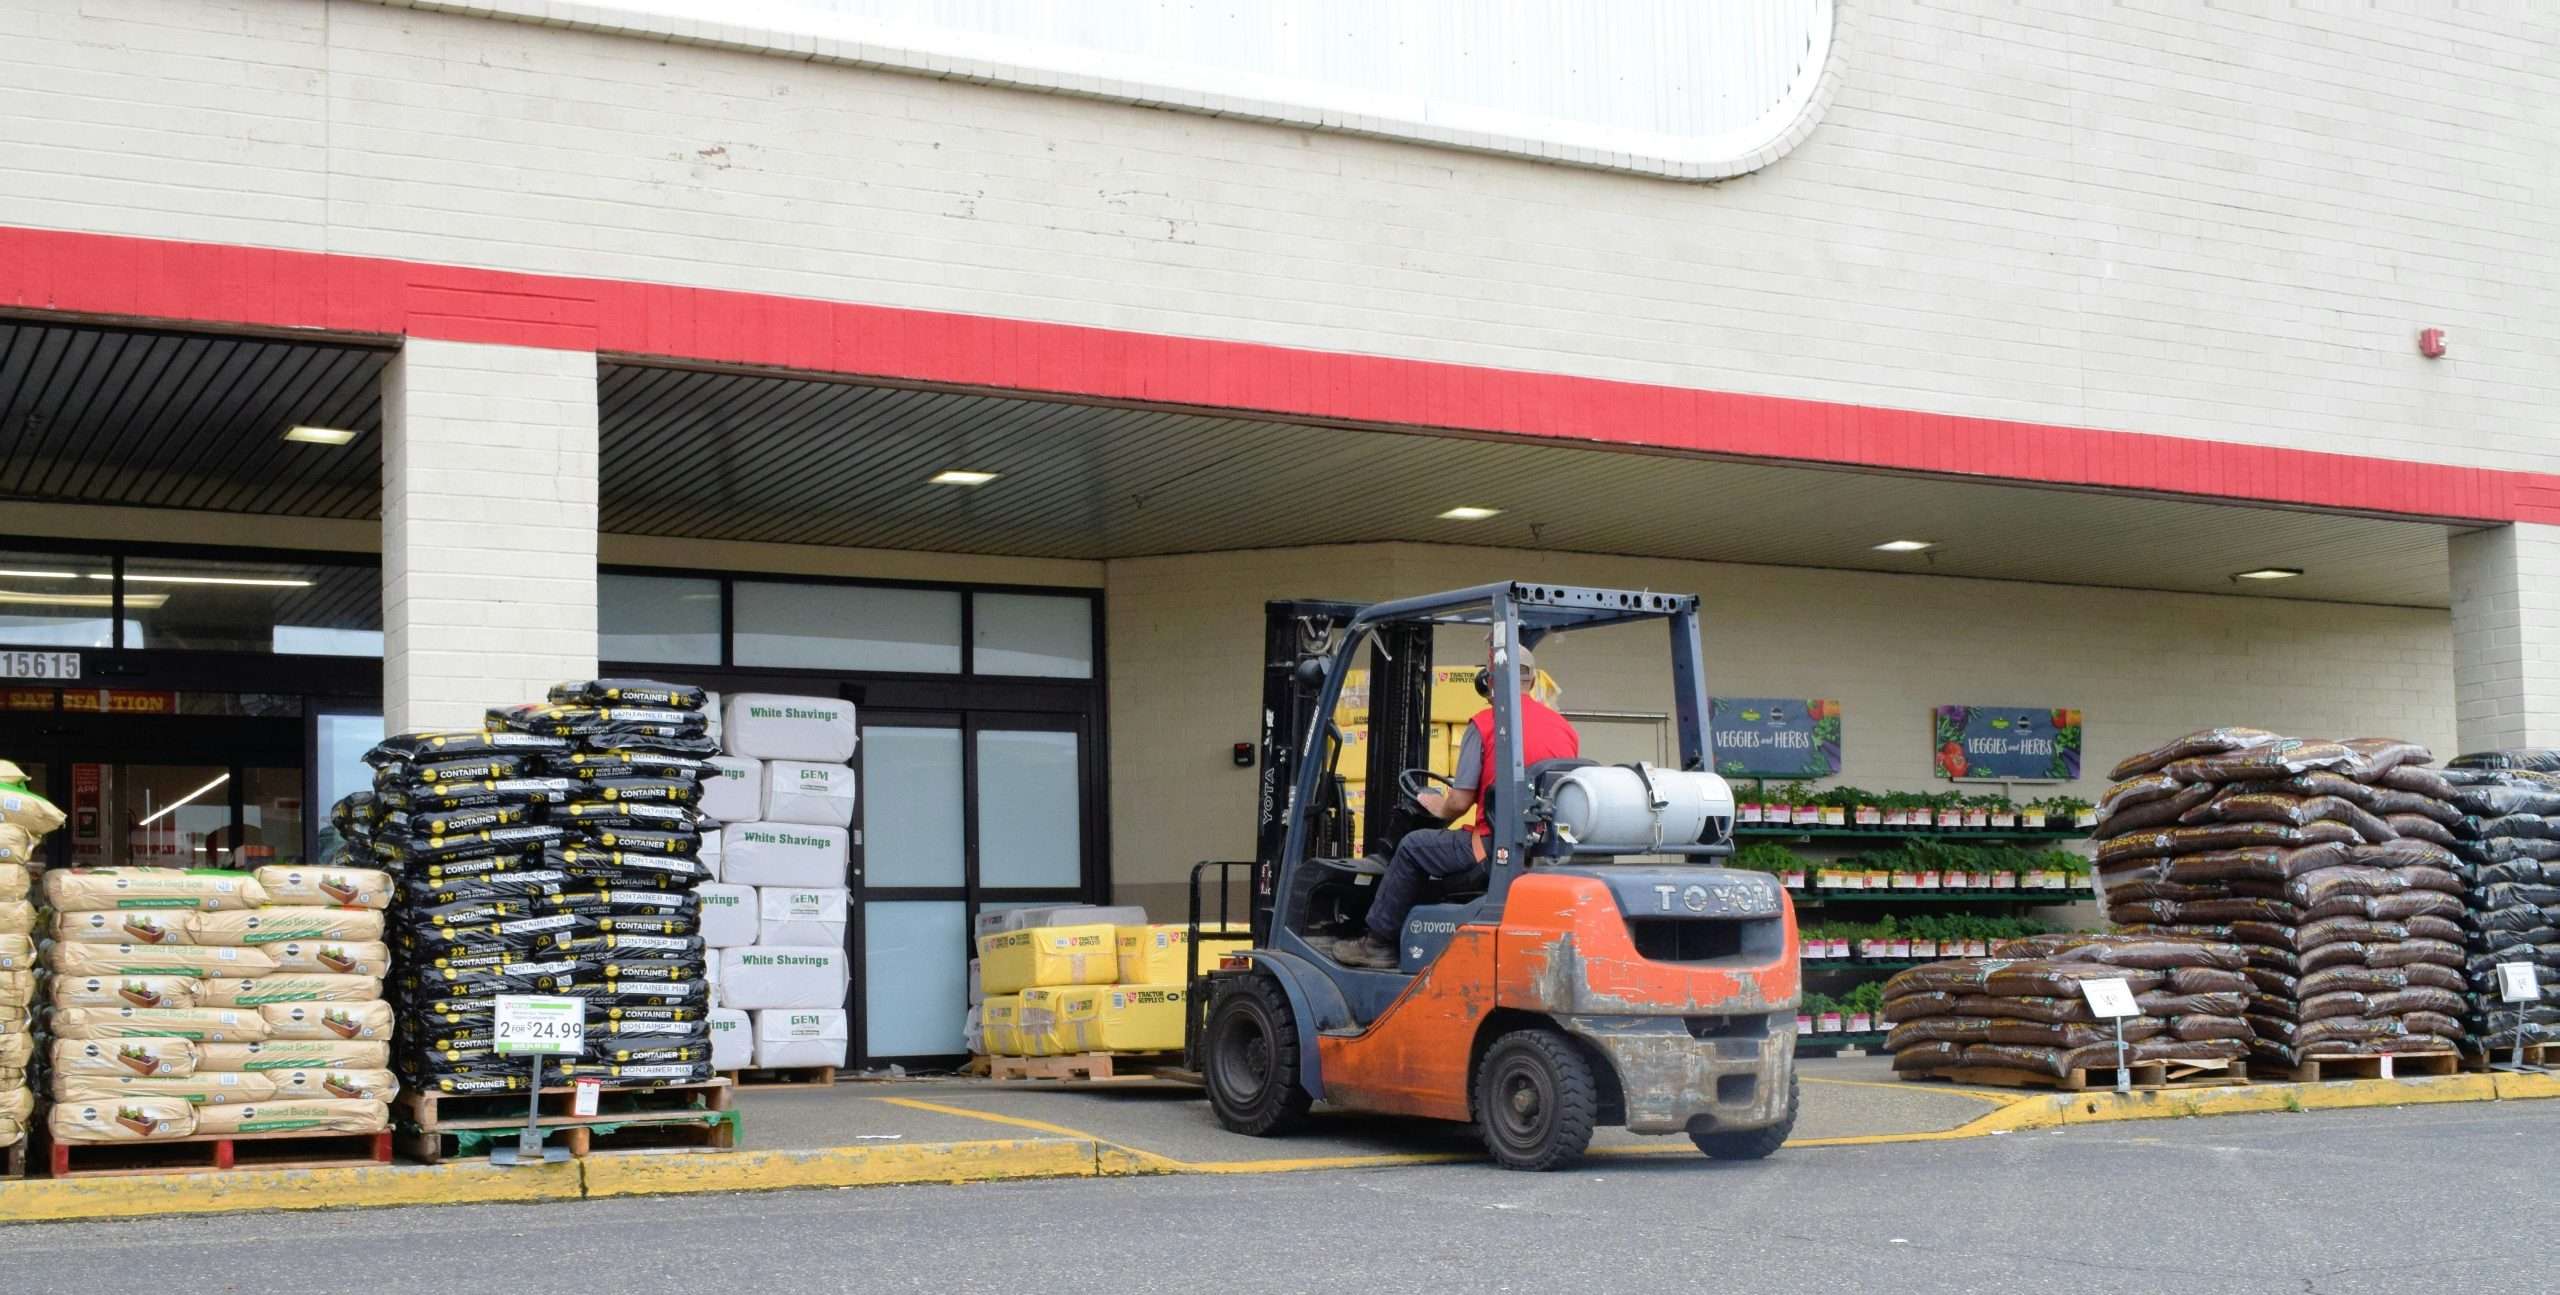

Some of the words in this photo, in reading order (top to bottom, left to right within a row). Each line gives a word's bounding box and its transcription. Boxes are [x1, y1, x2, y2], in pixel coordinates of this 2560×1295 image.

[3, 653, 79, 679] 15615
[8, 692, 165, 711] SATSFATION
[622, 692, 669, 703] CONTAINER
[750, 706, 783, 718] White
[785, 707, 838, 721] Shavings
[555, 726, 570, 736] 2X
[1716, 730, 1760, 748] VEGGIES
[1760, 735, 1774, 745] and
[1774, 730, 1809, 748] HERBS
[1968, 737, 2008, 754] VEGGIES
[2008, 743, 2020, 751] and
[2020, 738, 2052, 755] HERBS
[439, 767, 490, 779] CONTAINER
[578, 767, 594, 778] 2X
[800, 769, 829, 780] GEM
[620, 789, 667, 798] CONTAINER
[448, 814, 497, 829] CONTAINER
[618, 838, 665, 849] CONTAINER
[744, 831, 776, 844] White
[778, 833, 831, 849] Shavings
[445, 862, 494, 875] CONTAINER
[610, 878, 657, 887] CONTAINER
[613, 892, 663, 901] CONTAINER
[701, 893, 739, 907] avings
[1652, 884, 1778, 913] TOYOTA
[447, 907, 496, 922] CONTAINER
[615, 922, 663, 931] CONTAINER
[1423, 921, 1457, 934] TOYOTA
[450, 946, 467, 957] 2X
[451, 956, 500, 967] CONTAINER
[742, 954, 774, 966] White
[776, 954, 829, 968] Shavings
[621, 969, 669, 977] CONTAINER
[451, 985, 468, 996] 2X
[619, 983, 669, 992] CONTAINER
[671, 984, 688, 993] MIX
[451, 1000, 496, 1012] CONTAINE
[625, 1010, 672, 1018] CONTAINER
[711, 1019, 737, 1031] ings
[790, 1015, 820, 1025] GEM
[454, 1029, 470, 1040] 2X
[500, 1021, 511, 1038] 2
[511, 1024, 526, 1033] FOR
[527, 1021, 582, 1039] $24.99
[453, 1039, 495, 1049] CONTAIN
[632, 1052, 678, 1060] CONTAINER
[622, 1065, 672, 1073] CONTAINER
[456, 1079, 506, 1090] CONTAINER
